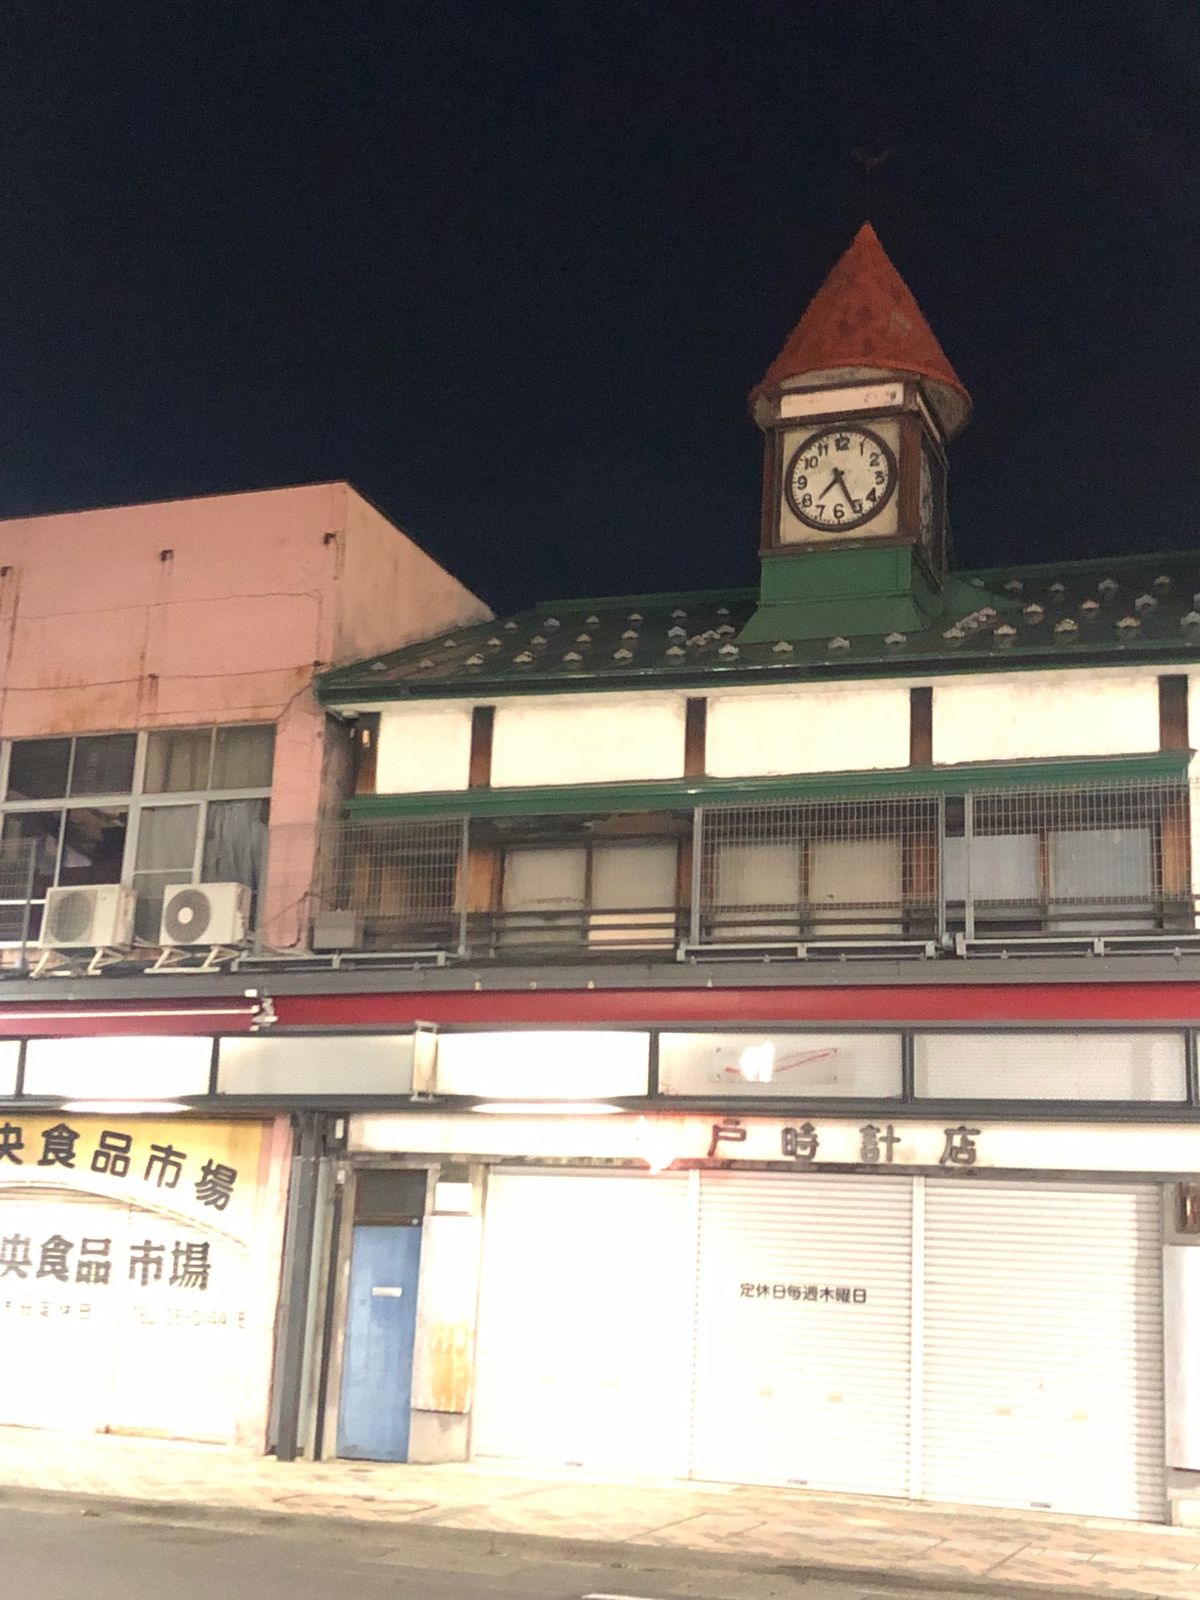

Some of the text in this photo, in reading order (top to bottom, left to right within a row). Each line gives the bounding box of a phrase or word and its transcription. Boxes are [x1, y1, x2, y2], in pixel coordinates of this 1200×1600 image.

[818, 442, 829, 456] 11
[835, 435, 850, 451] 12
[804, 456, 819, 470] 10
[869, 452, 880, 467] 2
[797, 475, 808, 490] 9
[874, 471, 885, 485] 3
[802, 493, 812, 508] 8
[866, 487, 877, 503] 4
[815, 504, 826, 520] 7
[833, 503, 845, 519] 6
[852, 499, 864, 514] 5
[0, 1122, 238, 1211] 央食品市場
[740, 1283, 867, 1304] 定休日毎週木曜日
